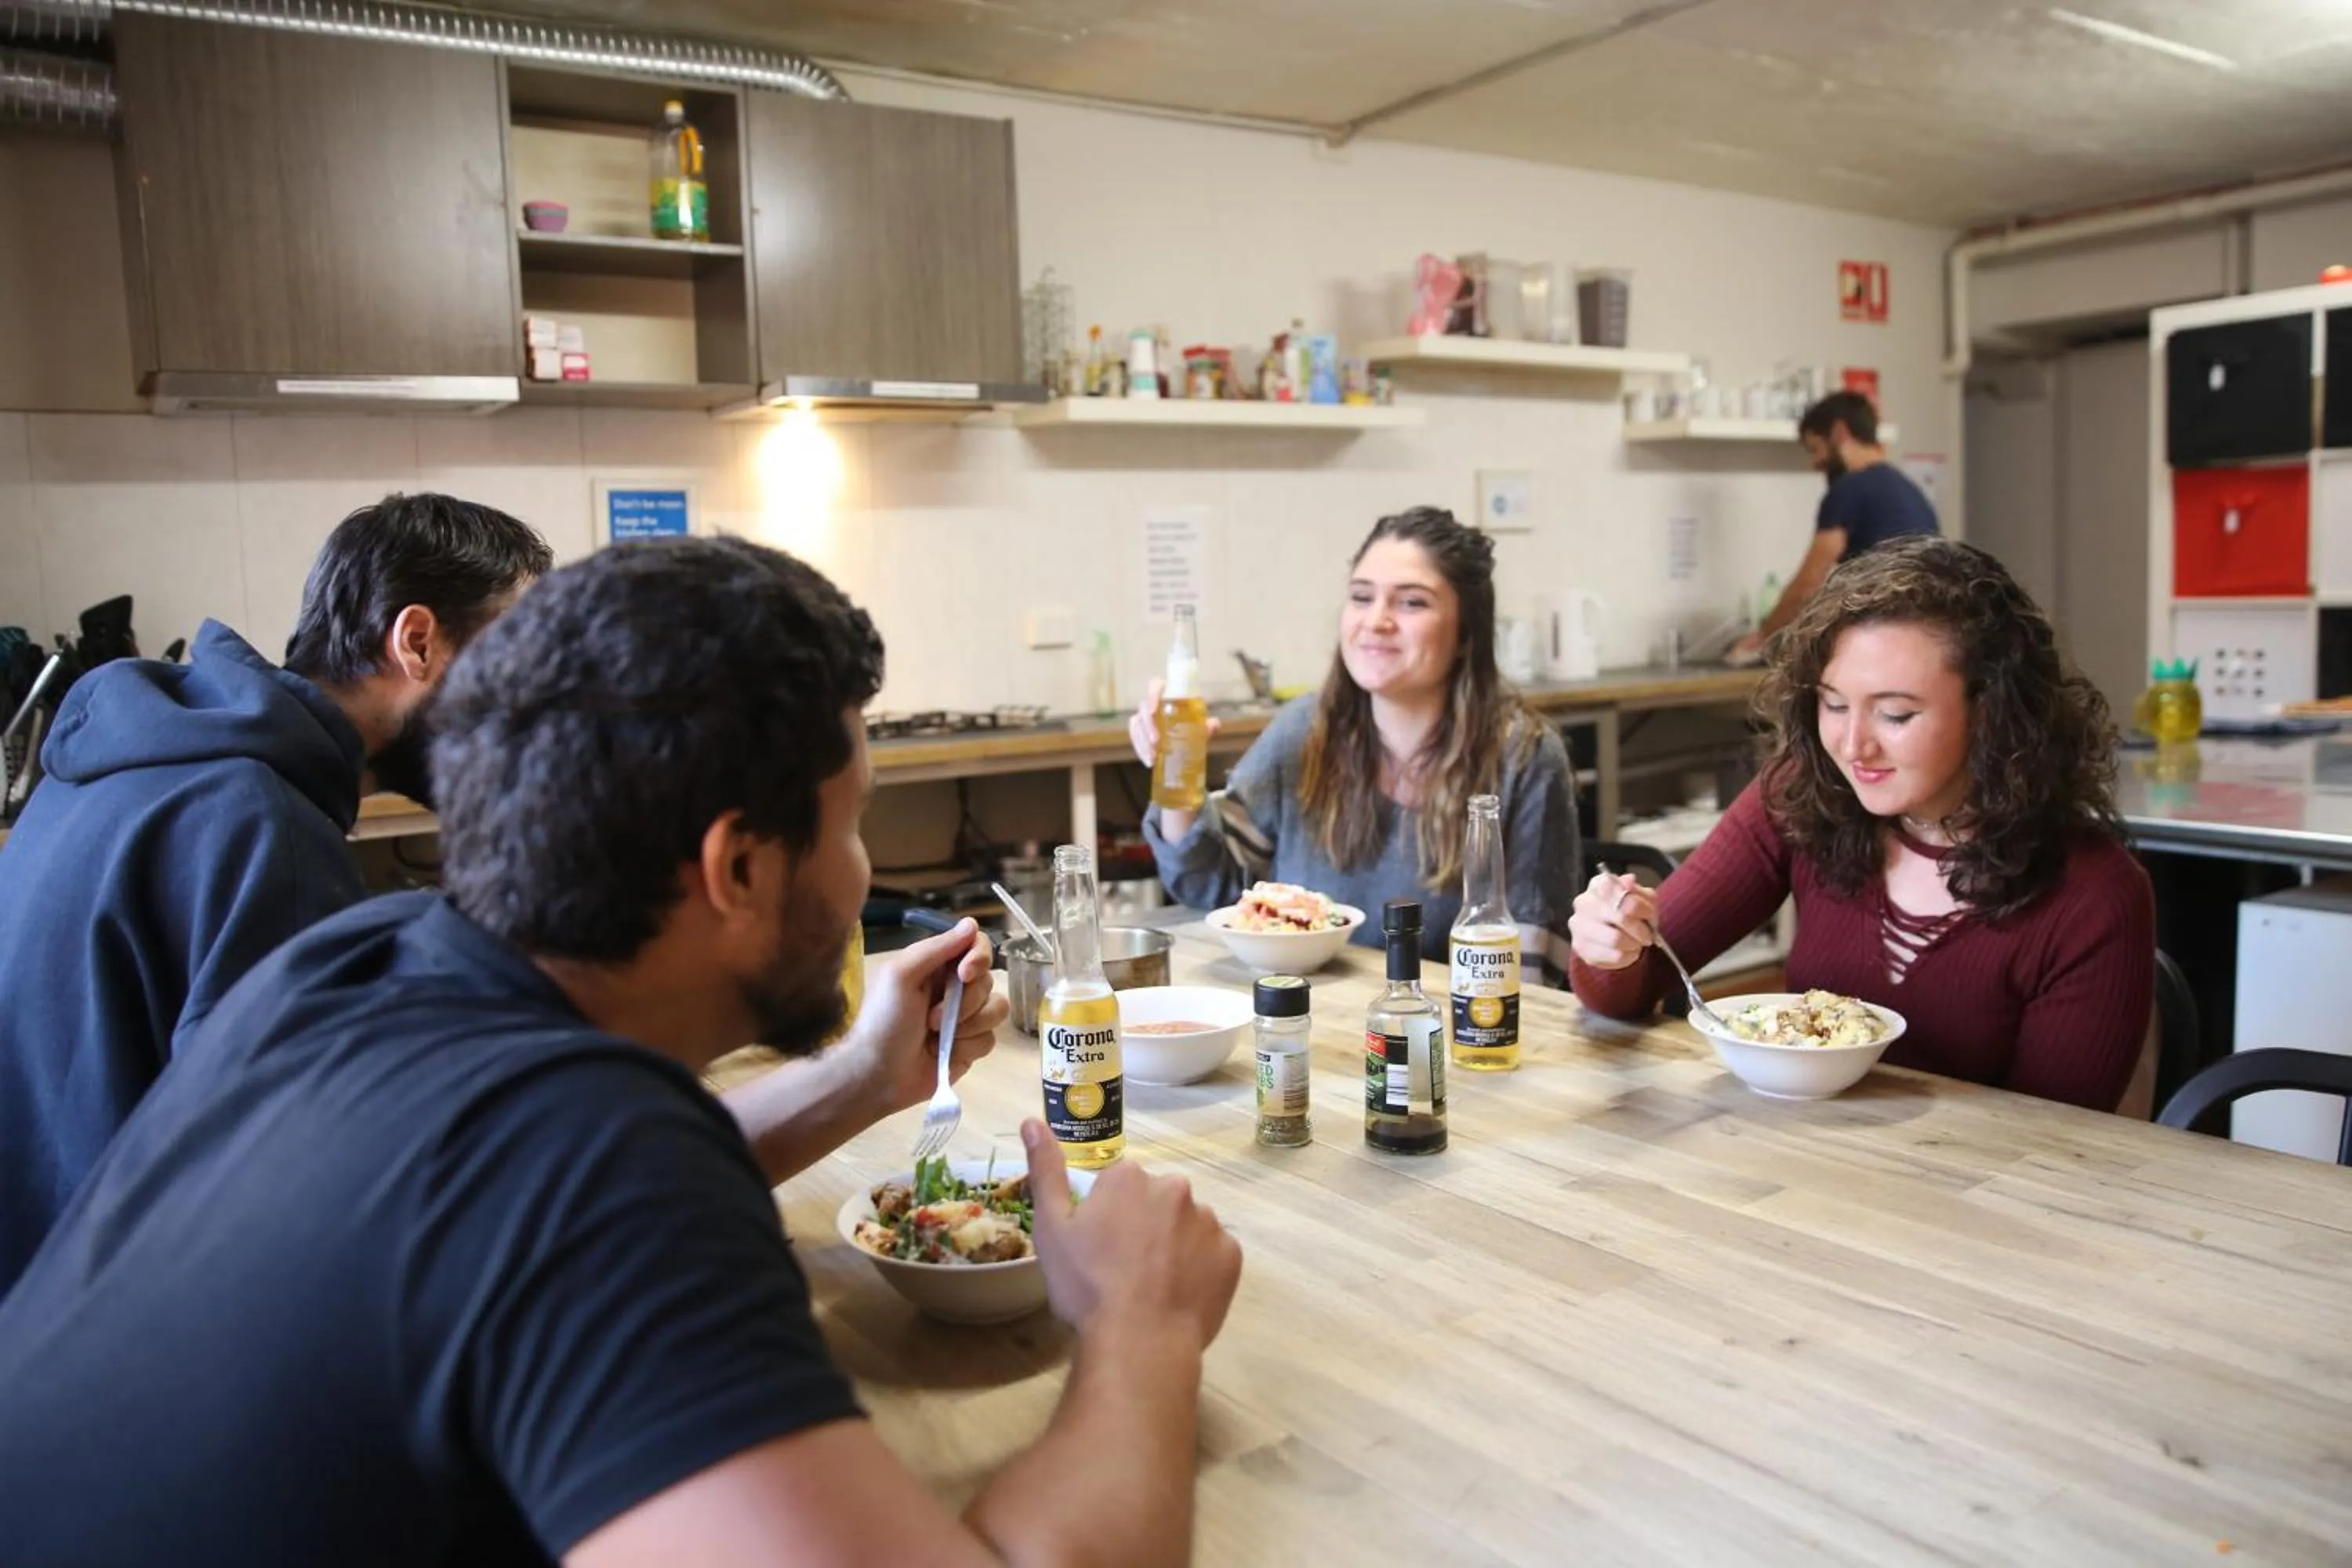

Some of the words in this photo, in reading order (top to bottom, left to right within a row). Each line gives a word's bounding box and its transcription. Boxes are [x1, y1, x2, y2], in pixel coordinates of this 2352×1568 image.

[1456, 947, 1515, 967] Corona
[1472, 965, 1505, 979] Extra
[1047, 1028, 1116, 1052] Corona
[1066, 1048, 1105, 1063] Extra
